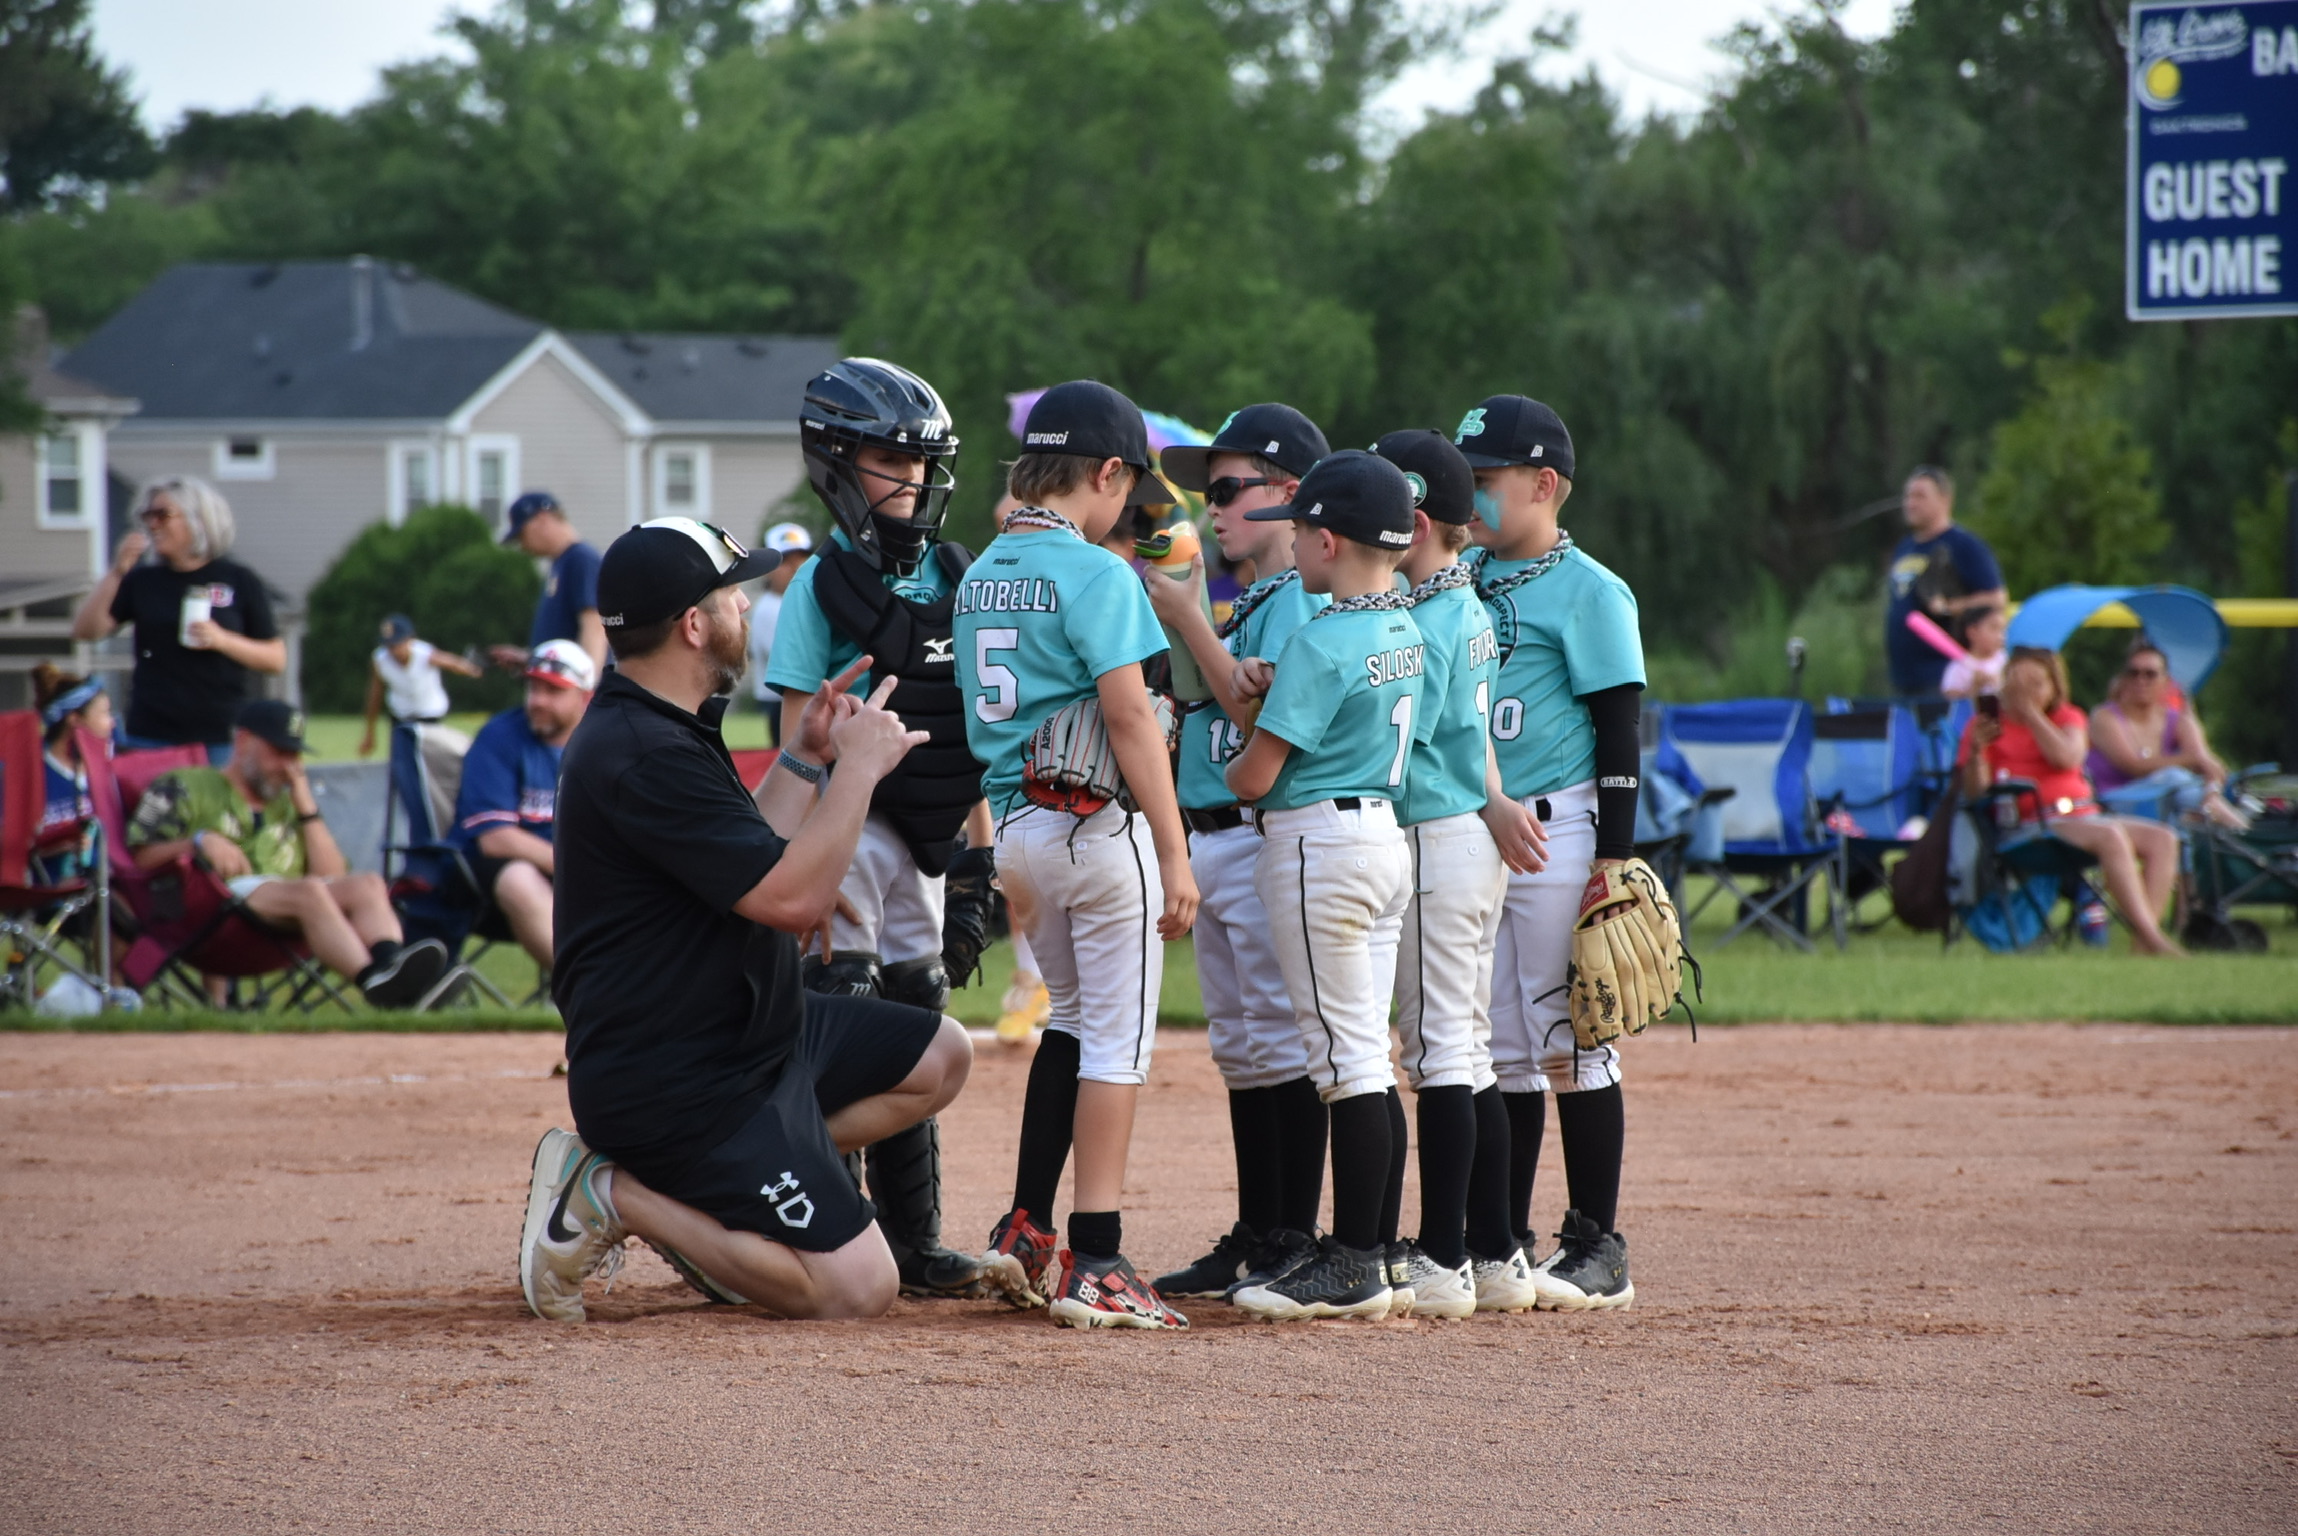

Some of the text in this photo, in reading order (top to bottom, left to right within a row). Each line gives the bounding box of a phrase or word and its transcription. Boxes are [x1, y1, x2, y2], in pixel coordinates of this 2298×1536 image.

[2144, 157, 2288, 222] GUEST
[2148, 234, 2282, 299] HOME
[1026, 430, 1069, 445] marucci
[975, 627, 1019, 724] 5
